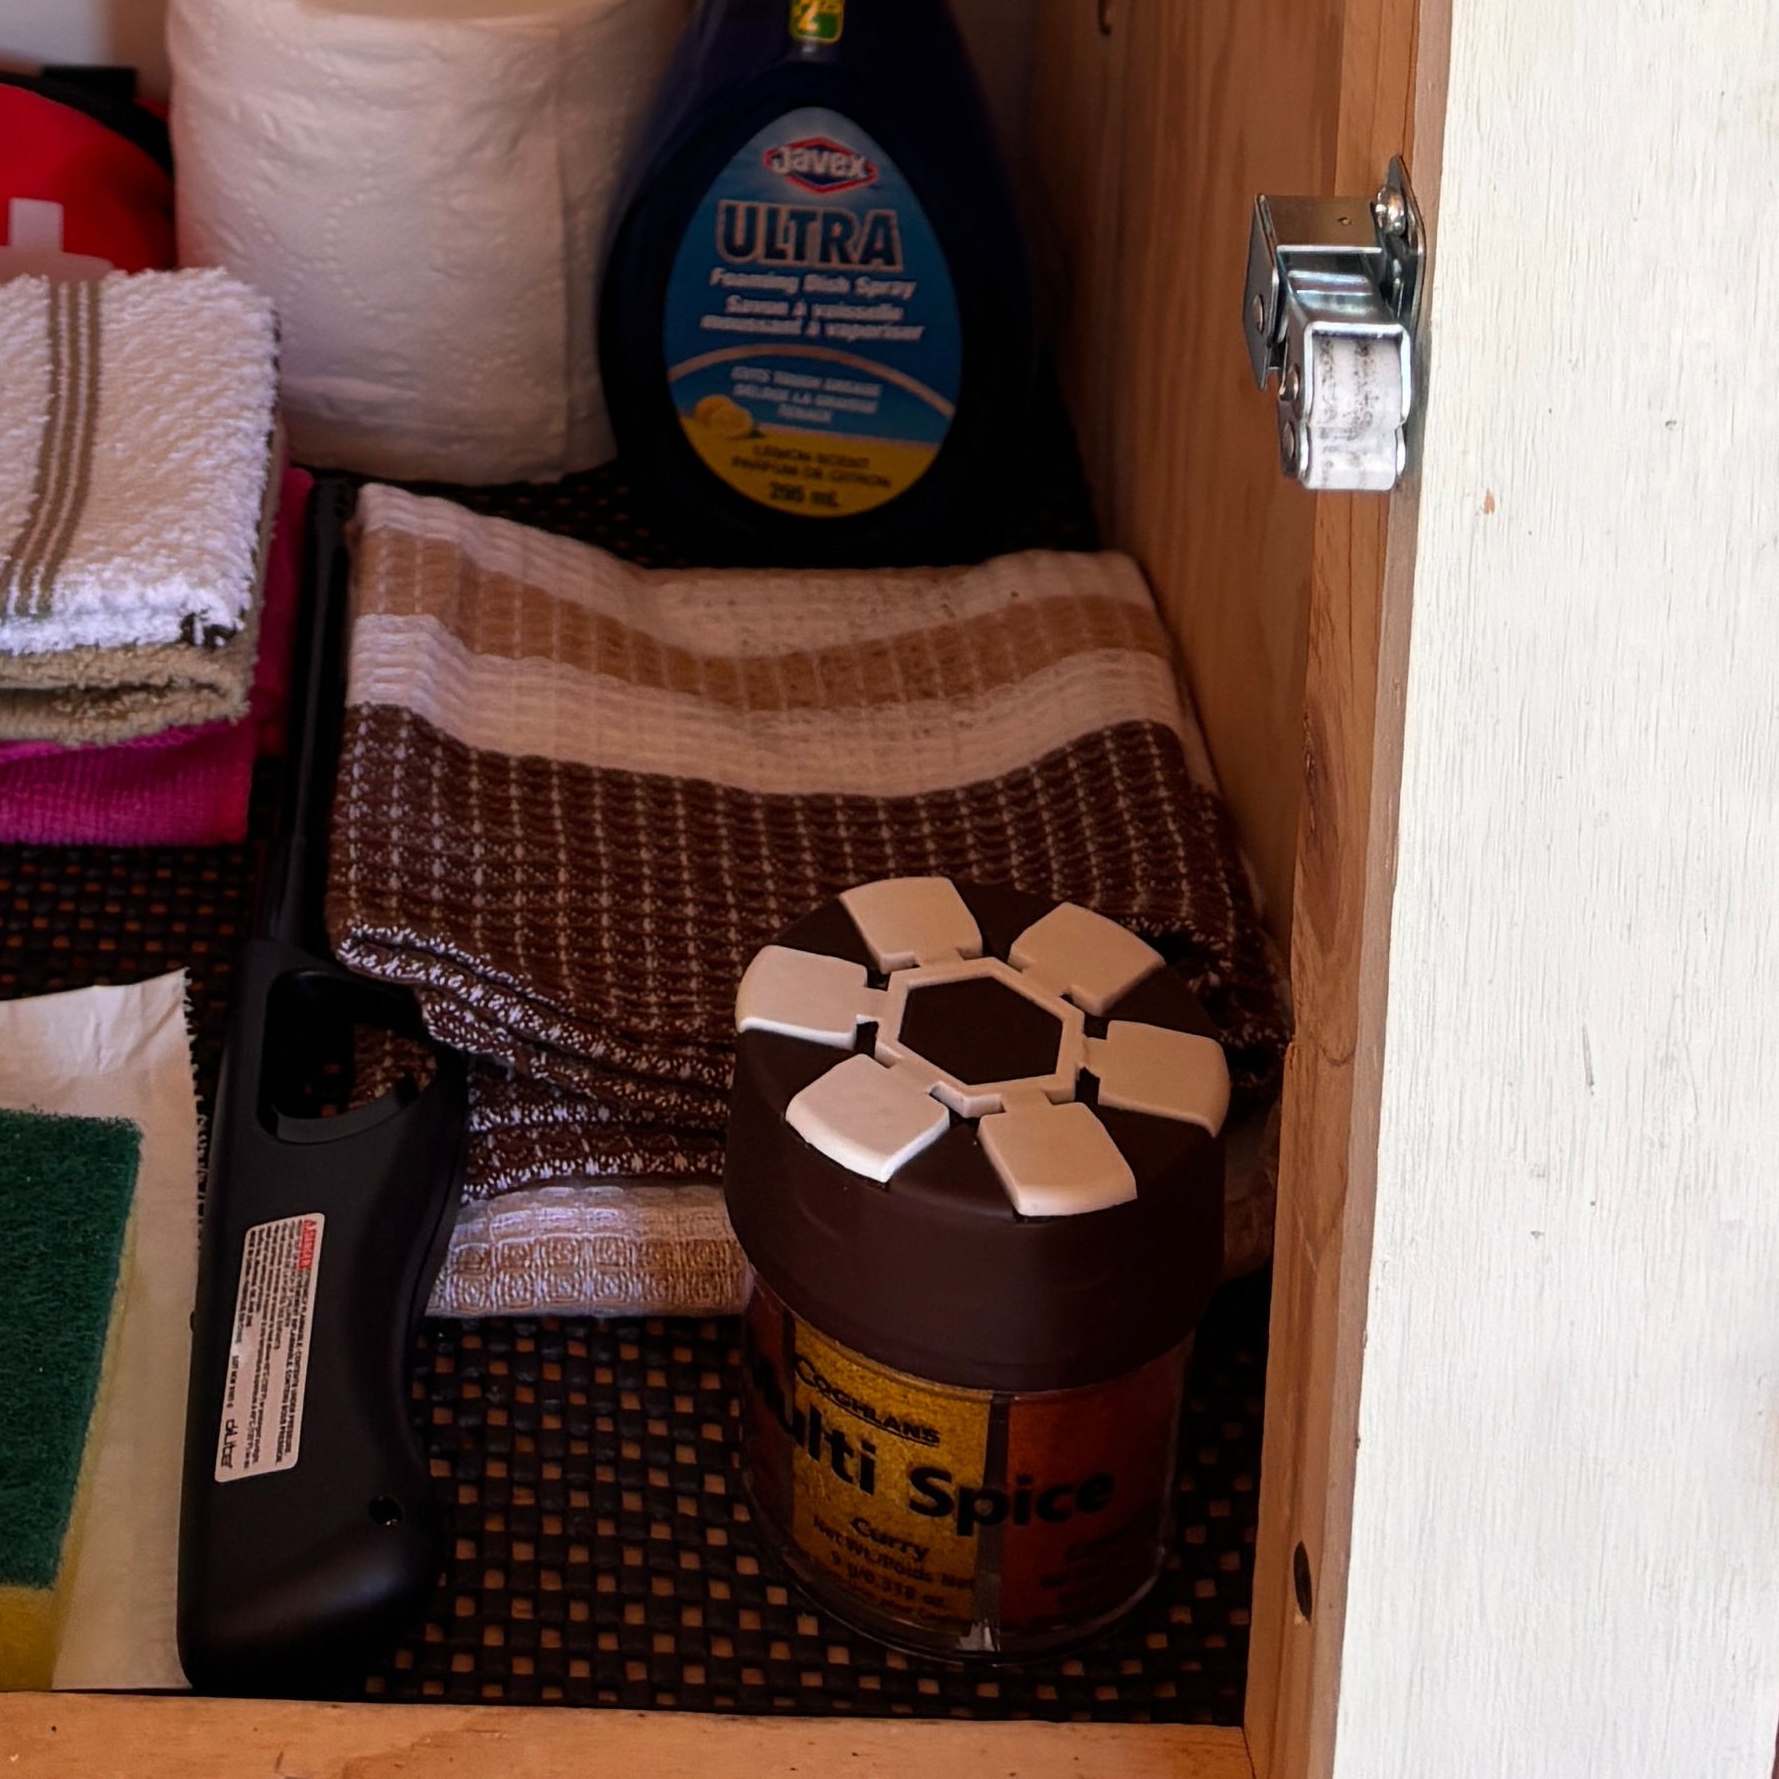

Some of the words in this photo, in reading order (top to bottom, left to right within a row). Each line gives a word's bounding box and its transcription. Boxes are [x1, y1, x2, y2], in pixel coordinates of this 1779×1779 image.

[771, 146, 869, 180] Javex
[715, 199, 904, 274] ULTRA
[908, 1466, 1116, 1537] Spice
[850, 1516, 929, 1562] Curry
